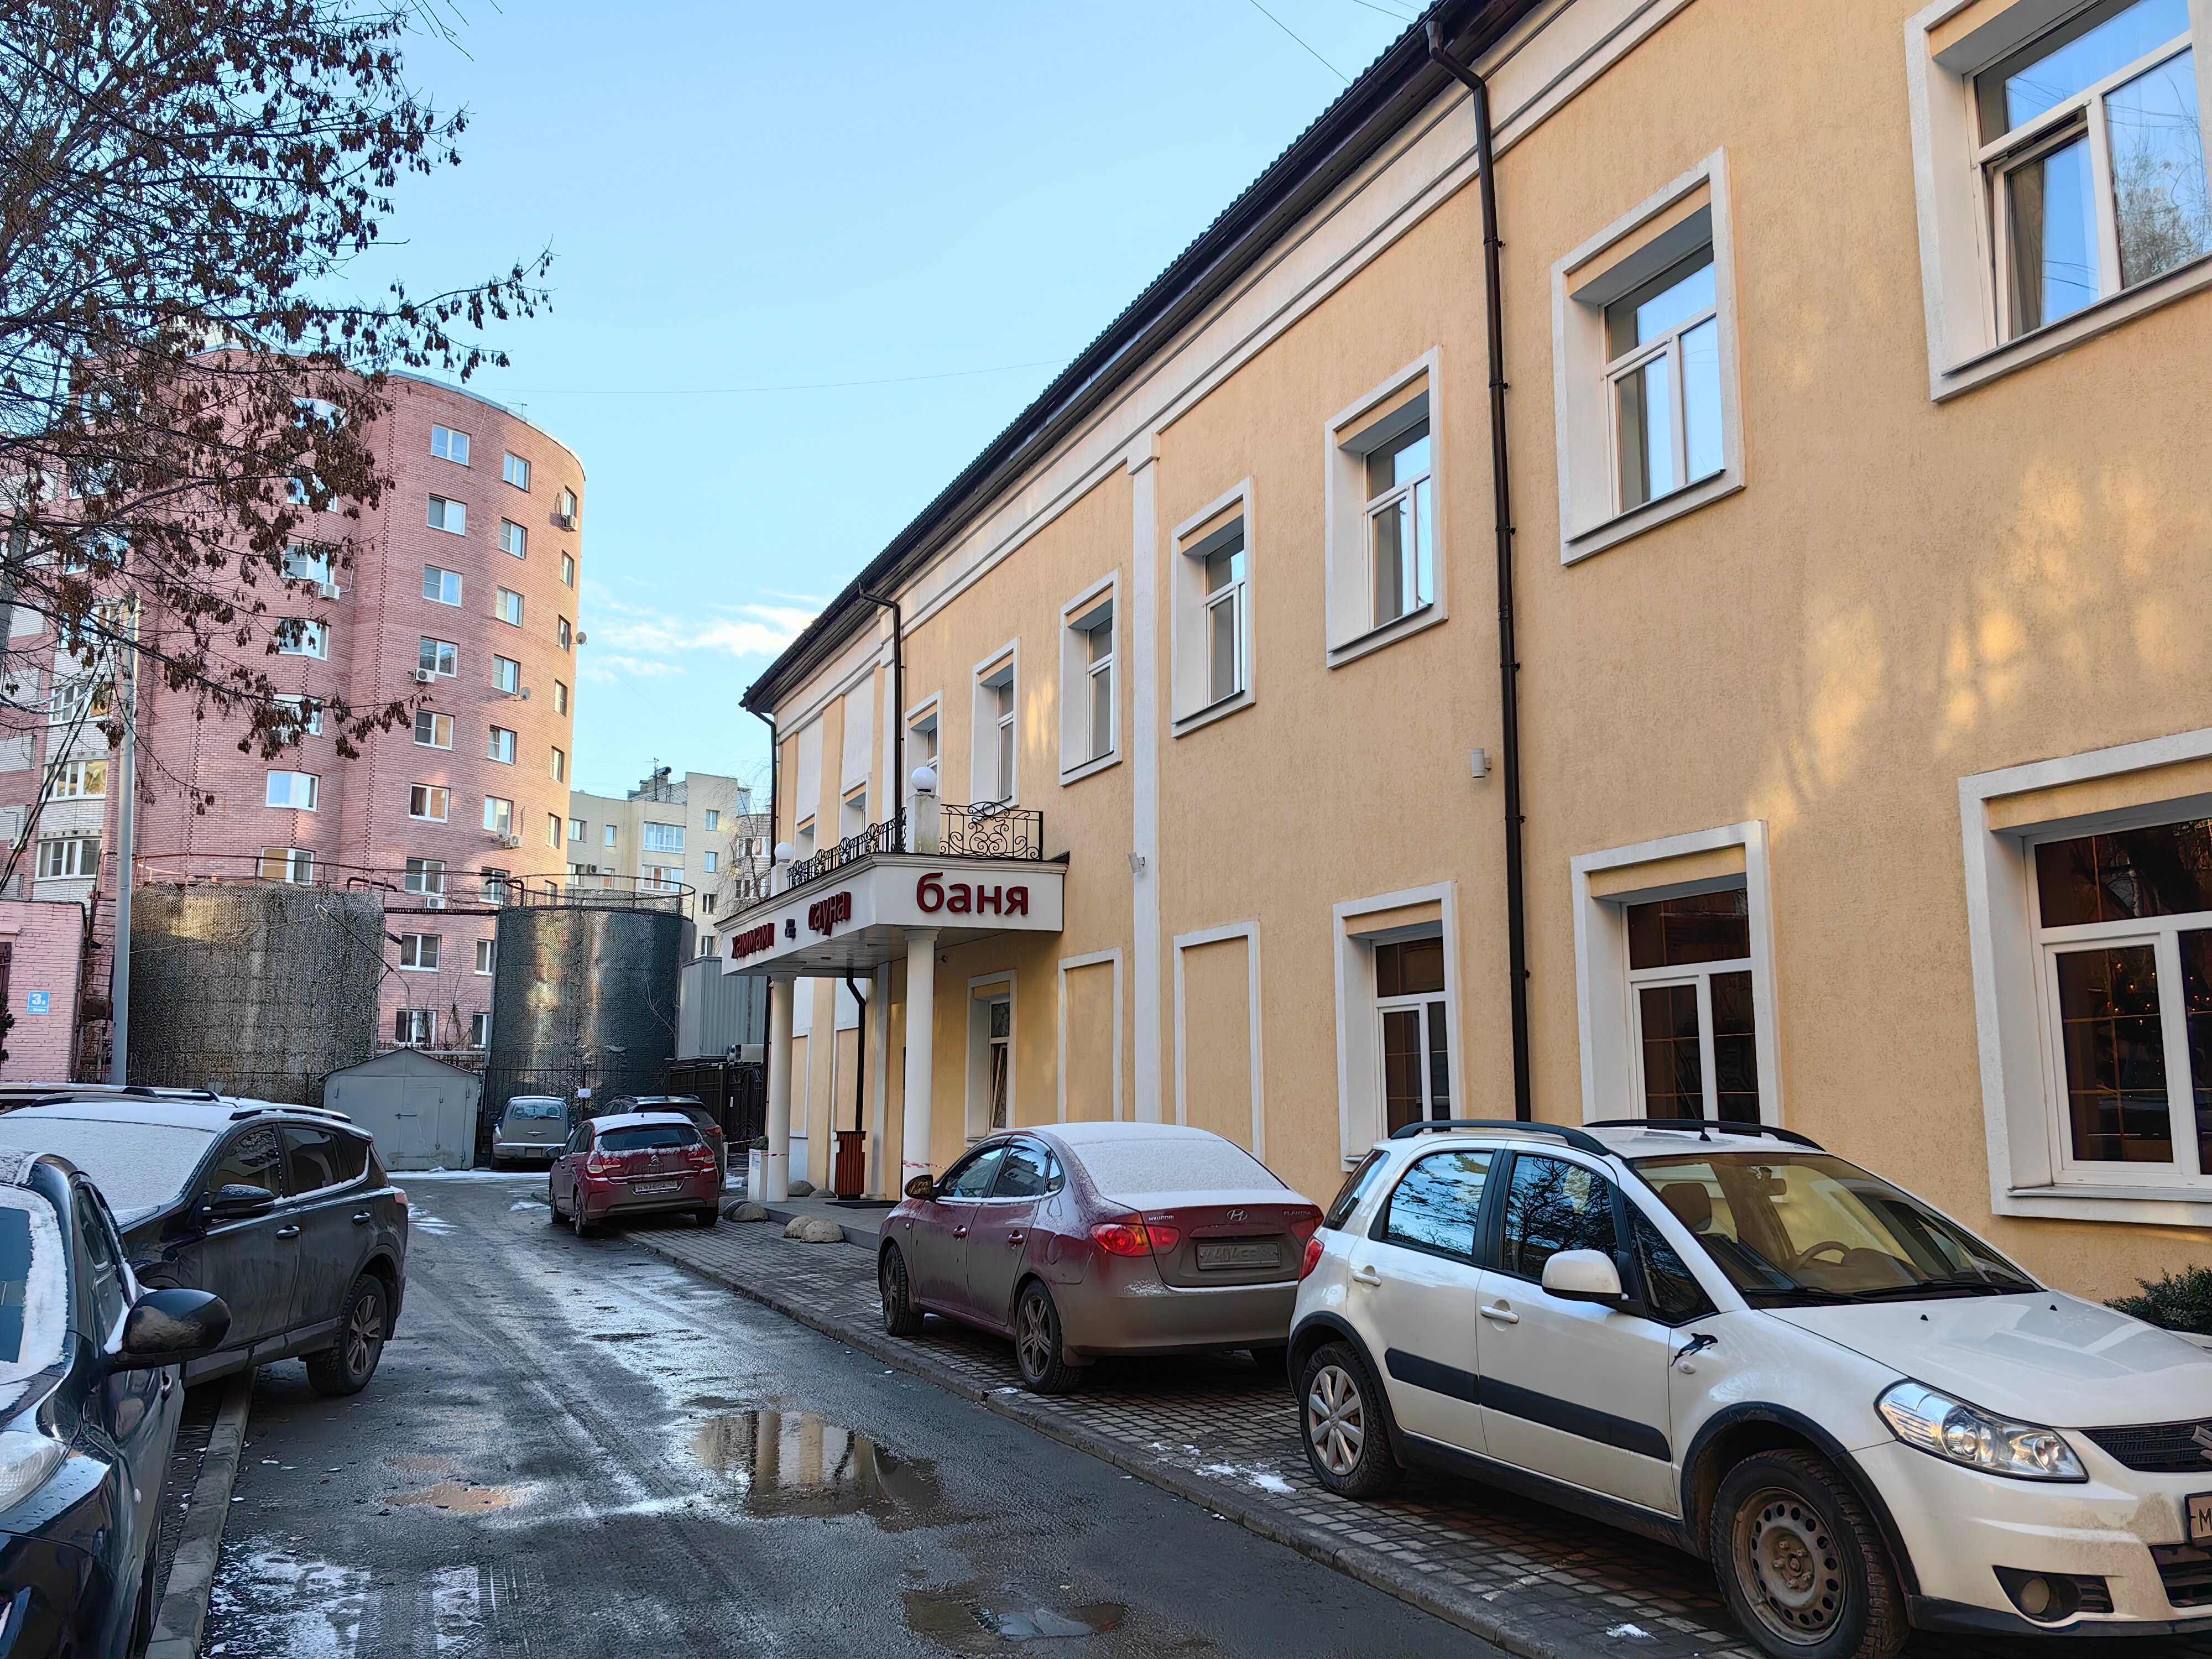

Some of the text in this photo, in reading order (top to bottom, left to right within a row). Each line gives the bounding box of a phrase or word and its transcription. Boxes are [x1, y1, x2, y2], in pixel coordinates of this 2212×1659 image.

[916, 872, 1029, 915] баня
[731, 923, 775, 959] хаммам
[808, 891, 851, 936] сауна
